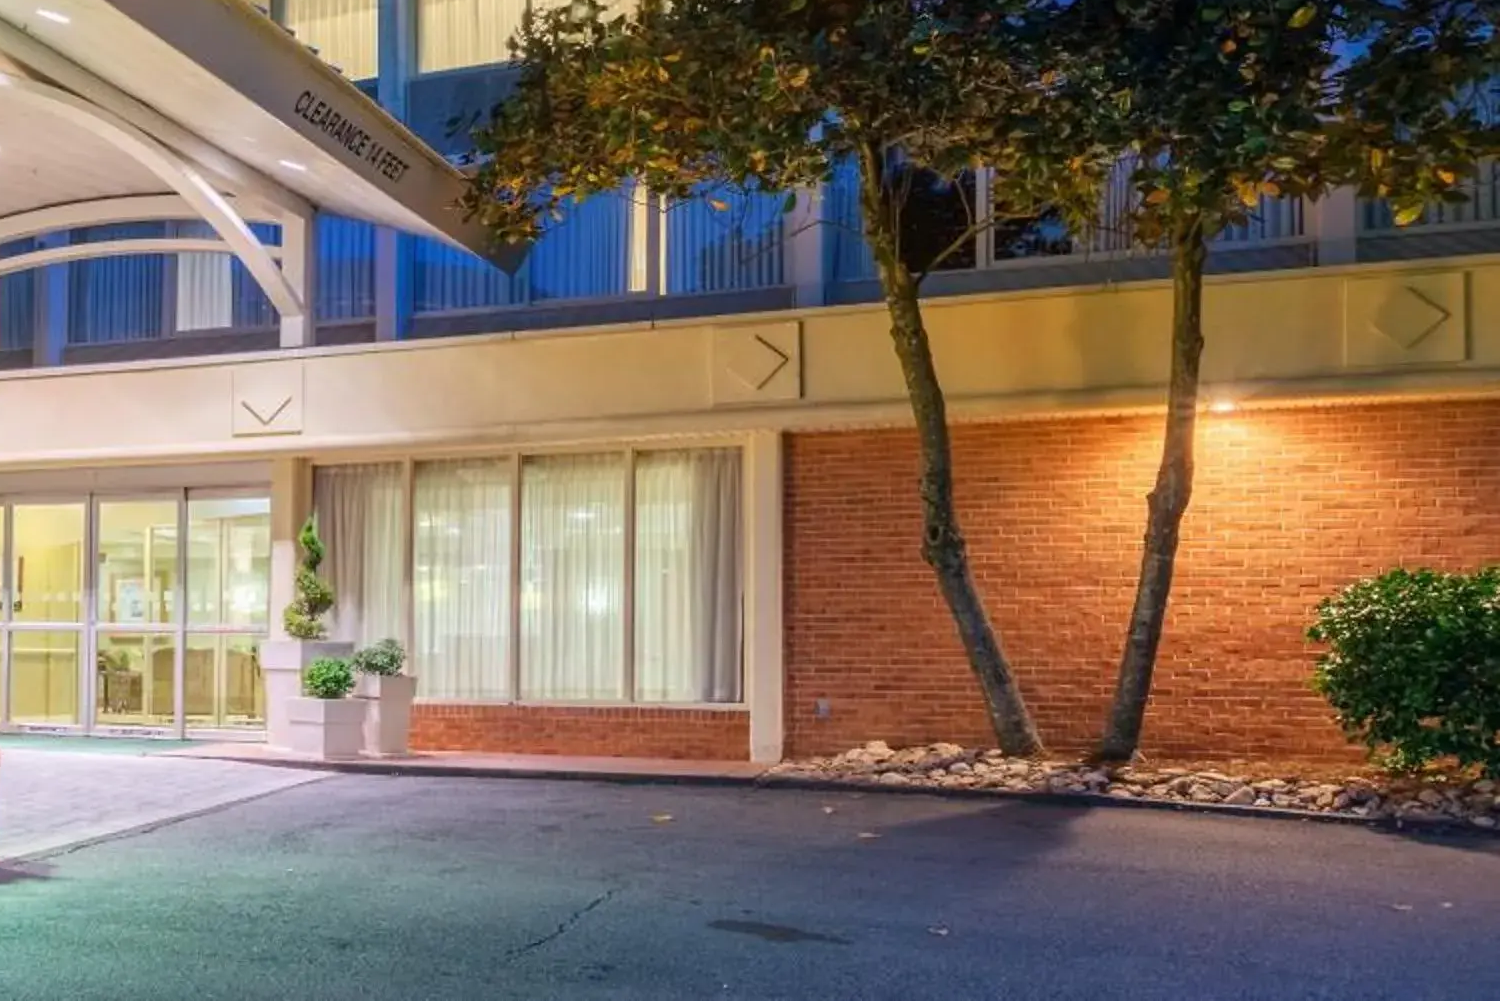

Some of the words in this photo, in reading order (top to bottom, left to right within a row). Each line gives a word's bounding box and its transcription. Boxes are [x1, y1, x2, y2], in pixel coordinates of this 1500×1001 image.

[294, 90, 370, 156] CLEARANCE
[365, 142, 384, 164] 14
[377, 151, 409, 183] FEET
